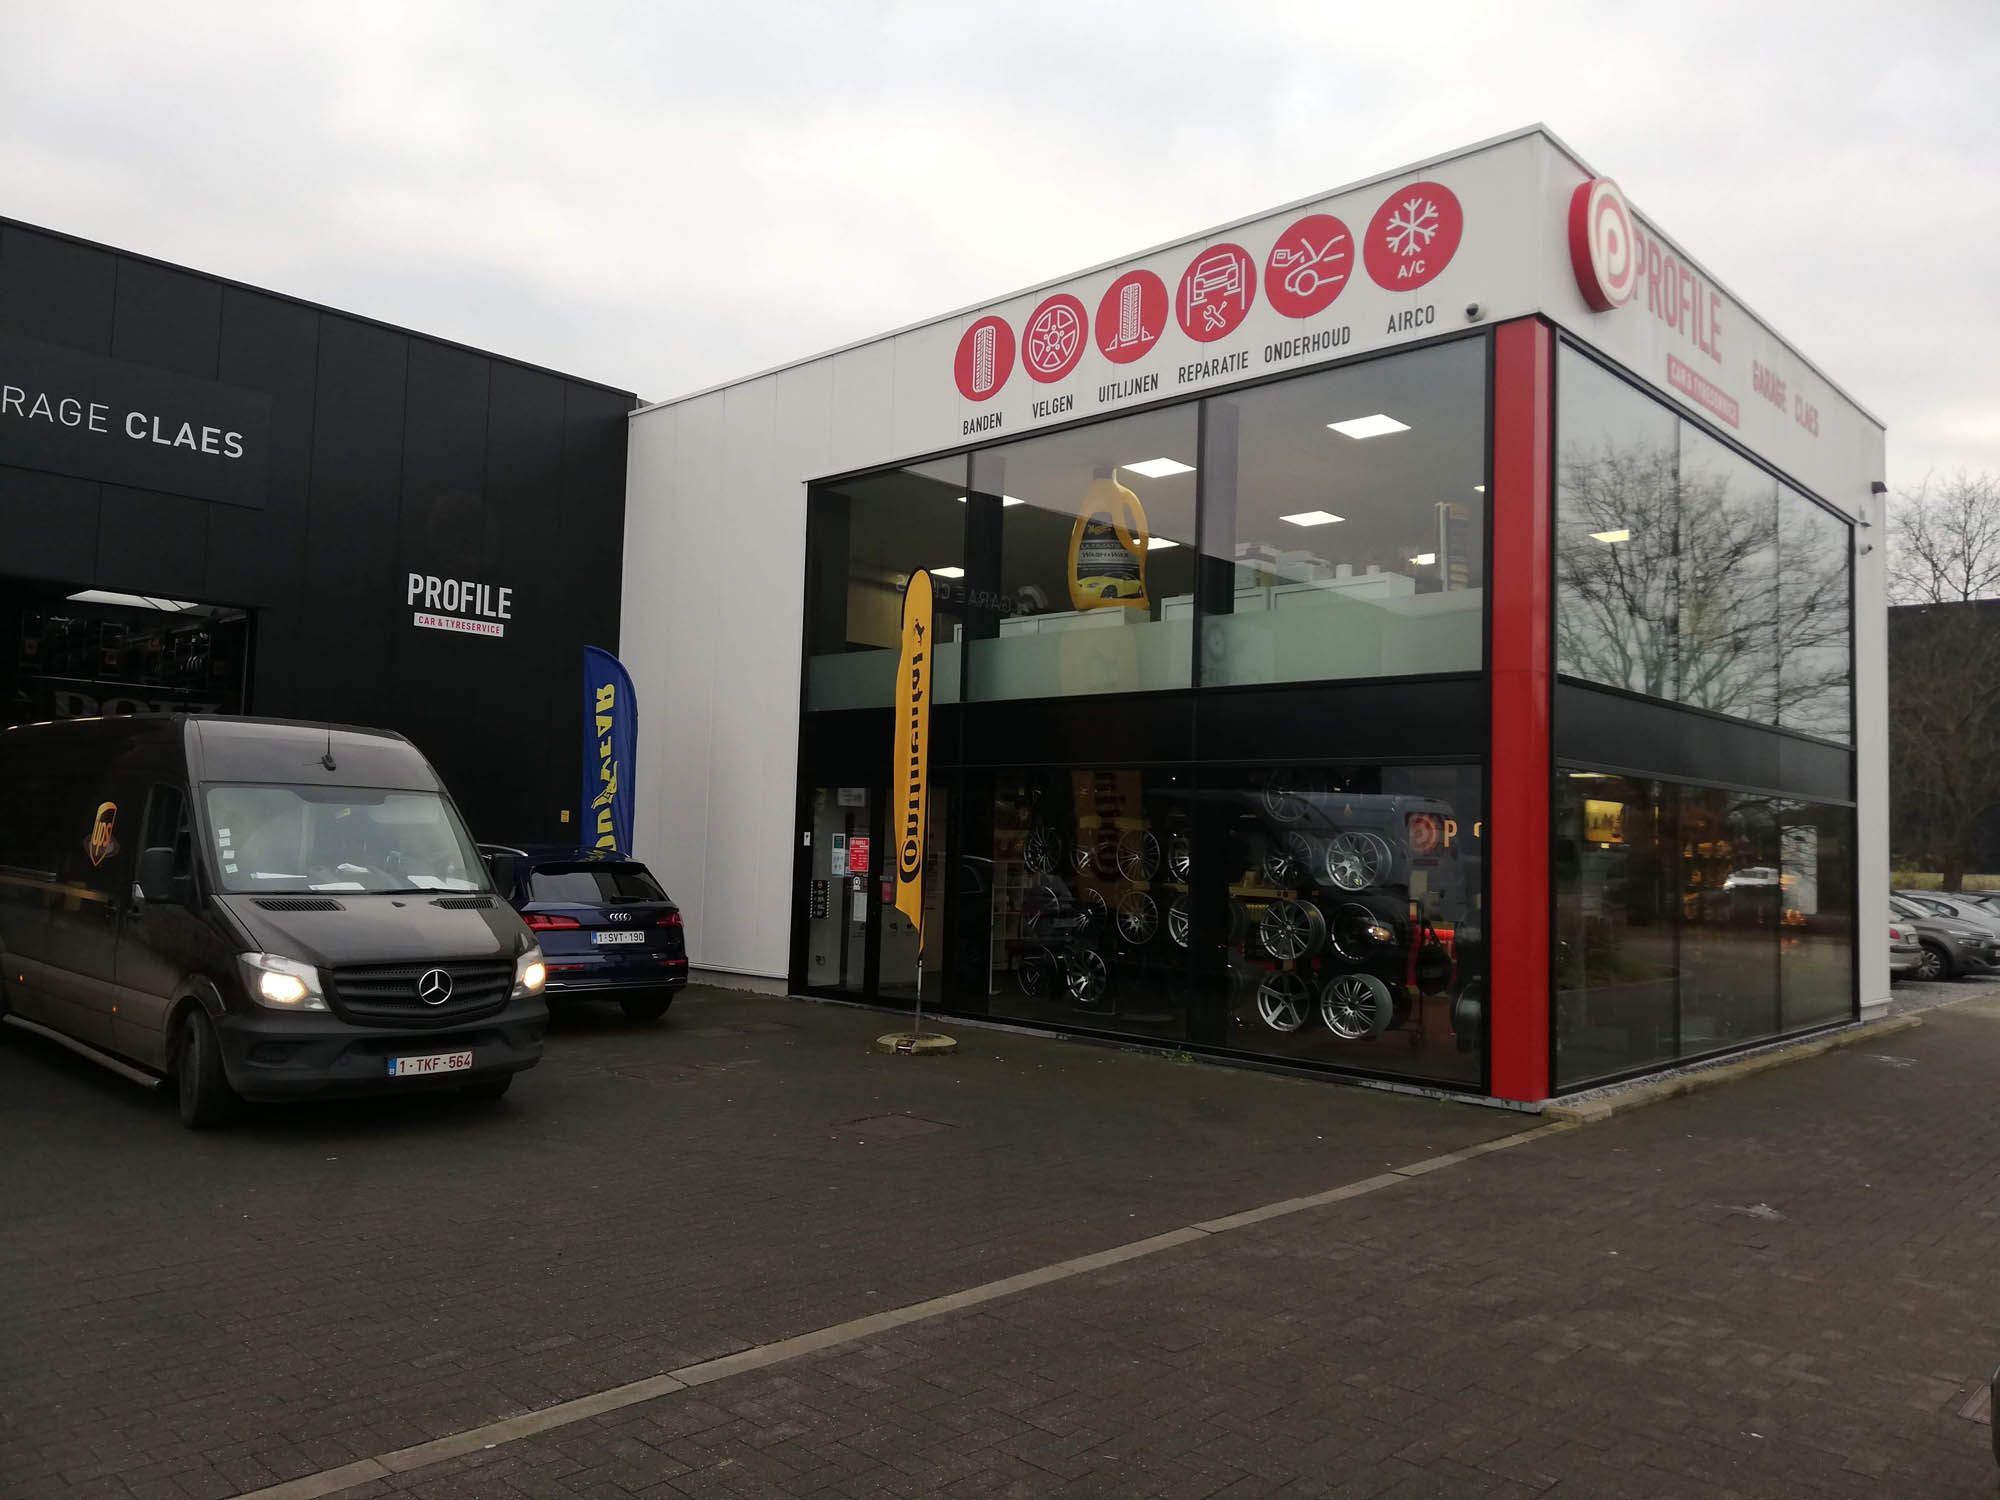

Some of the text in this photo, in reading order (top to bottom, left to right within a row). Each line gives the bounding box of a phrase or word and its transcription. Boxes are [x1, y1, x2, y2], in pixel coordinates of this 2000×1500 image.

[1398, 261, 1425, 279] A/C
[1387, 305, 1435, 334] AIRCO
[1264, 326, 1351, 363] ONDERHOUD
[1178, 351, 1249, 384] REPARATIE
[1099, 373, 1159, 402] UITLIJNEN
[1032, 394, 1073, 419] VELGEN
[2, 385, 244, 459] RAGE CLAES
[963, 412, 1002, 435] BANDEN
[407, 573, 513, 619] PROFILE
[418, 616, 501, 634] CAR & TYRESERVICE
